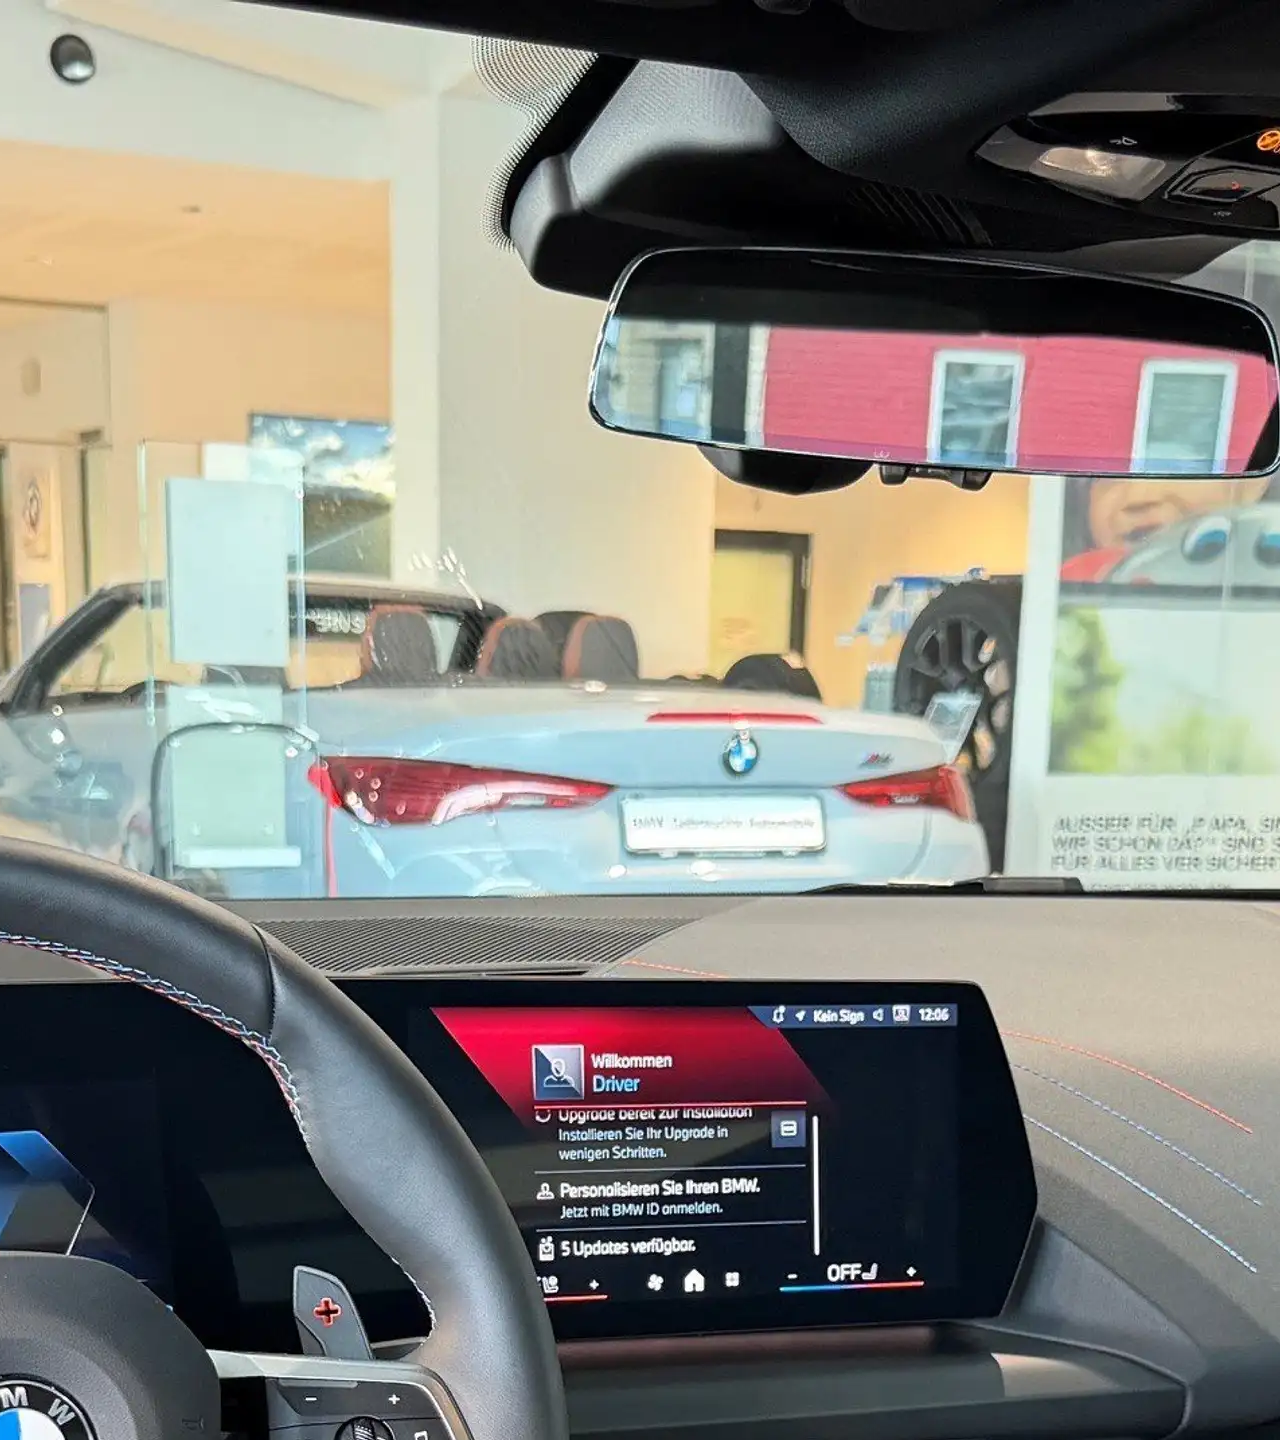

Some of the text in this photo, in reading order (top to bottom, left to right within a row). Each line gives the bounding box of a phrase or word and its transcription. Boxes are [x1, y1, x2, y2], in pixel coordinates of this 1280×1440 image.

[1222, 836, 1266, 853] SIND
[813, 1008, 865, 1025] Kein Sign
[919, 1007, 950, 1022] 12:06
[591, 1053, 673, 1069] Willkommen
[592, 1075, 641, 1093] Driver
[559, 1107, 753, 1125] Upgrade bereit zur Installation
[558, 1123, 728, 1142] Installieren Sie Ihr Upgrade in
[558, 1144, 667, 1162] wenigen Schritten.
[560, 1177, 761, 1198] Personalisieren Sie Ihren BMW.
[560, 1201, 724, 1219] Jetzt mit BMW ID anmelden.
[561, 1236, 696, 1258] 5 Updates verfügbar.
[827, 1263, 862, 1282] OFF
